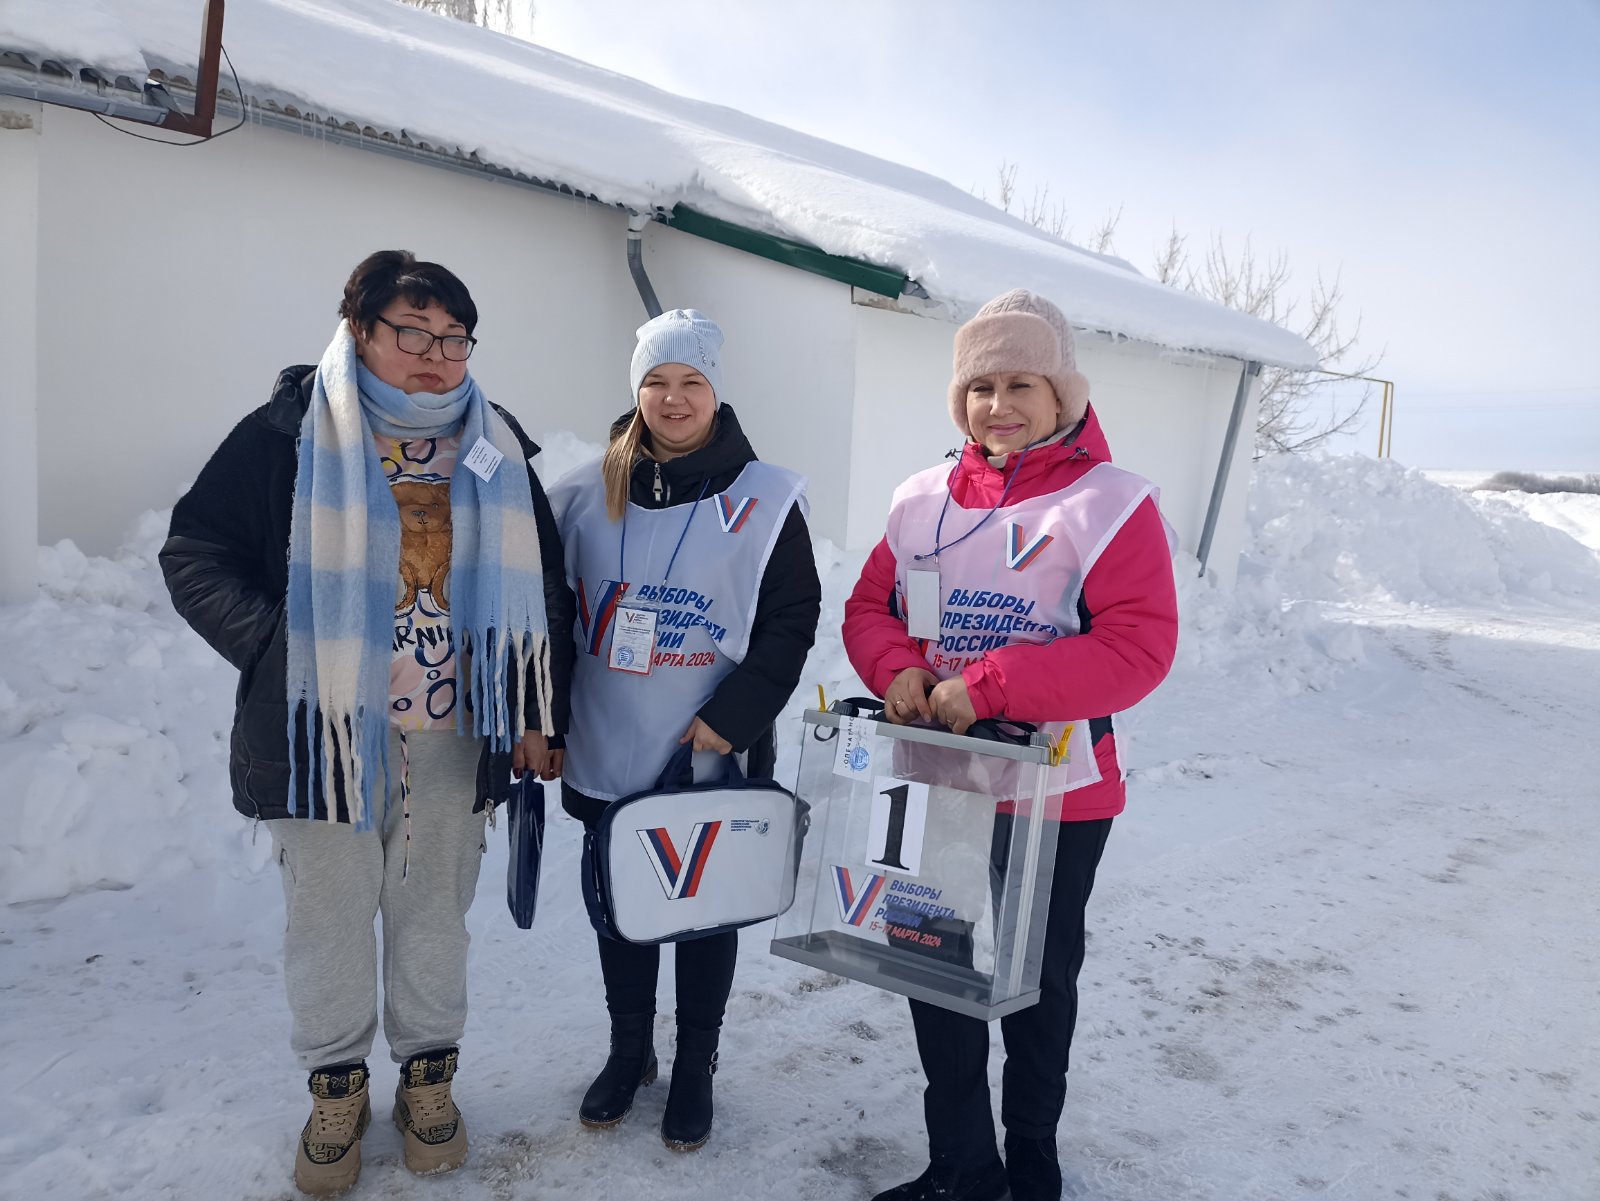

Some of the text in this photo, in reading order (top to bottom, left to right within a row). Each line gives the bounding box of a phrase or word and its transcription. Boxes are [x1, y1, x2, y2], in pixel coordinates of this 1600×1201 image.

[636, 584, 713, 612] ВЫБОРЫ
[947, 588, 1036, 616] ВЫБОРЫ
[659, 609, 727, 643] ЗИДЕНТА
[652, 652, 685, 667] АРТА
[686, 651, 716, 667] 2024
[871, 783, 910, 871] 1
[890, 879, 943, 900] ВЫБОРЫ
[874, 907, 923, 928] РОИИ
[890, 926, 921, 943] МАРТА
[920, 933, 942, 948] 2024
